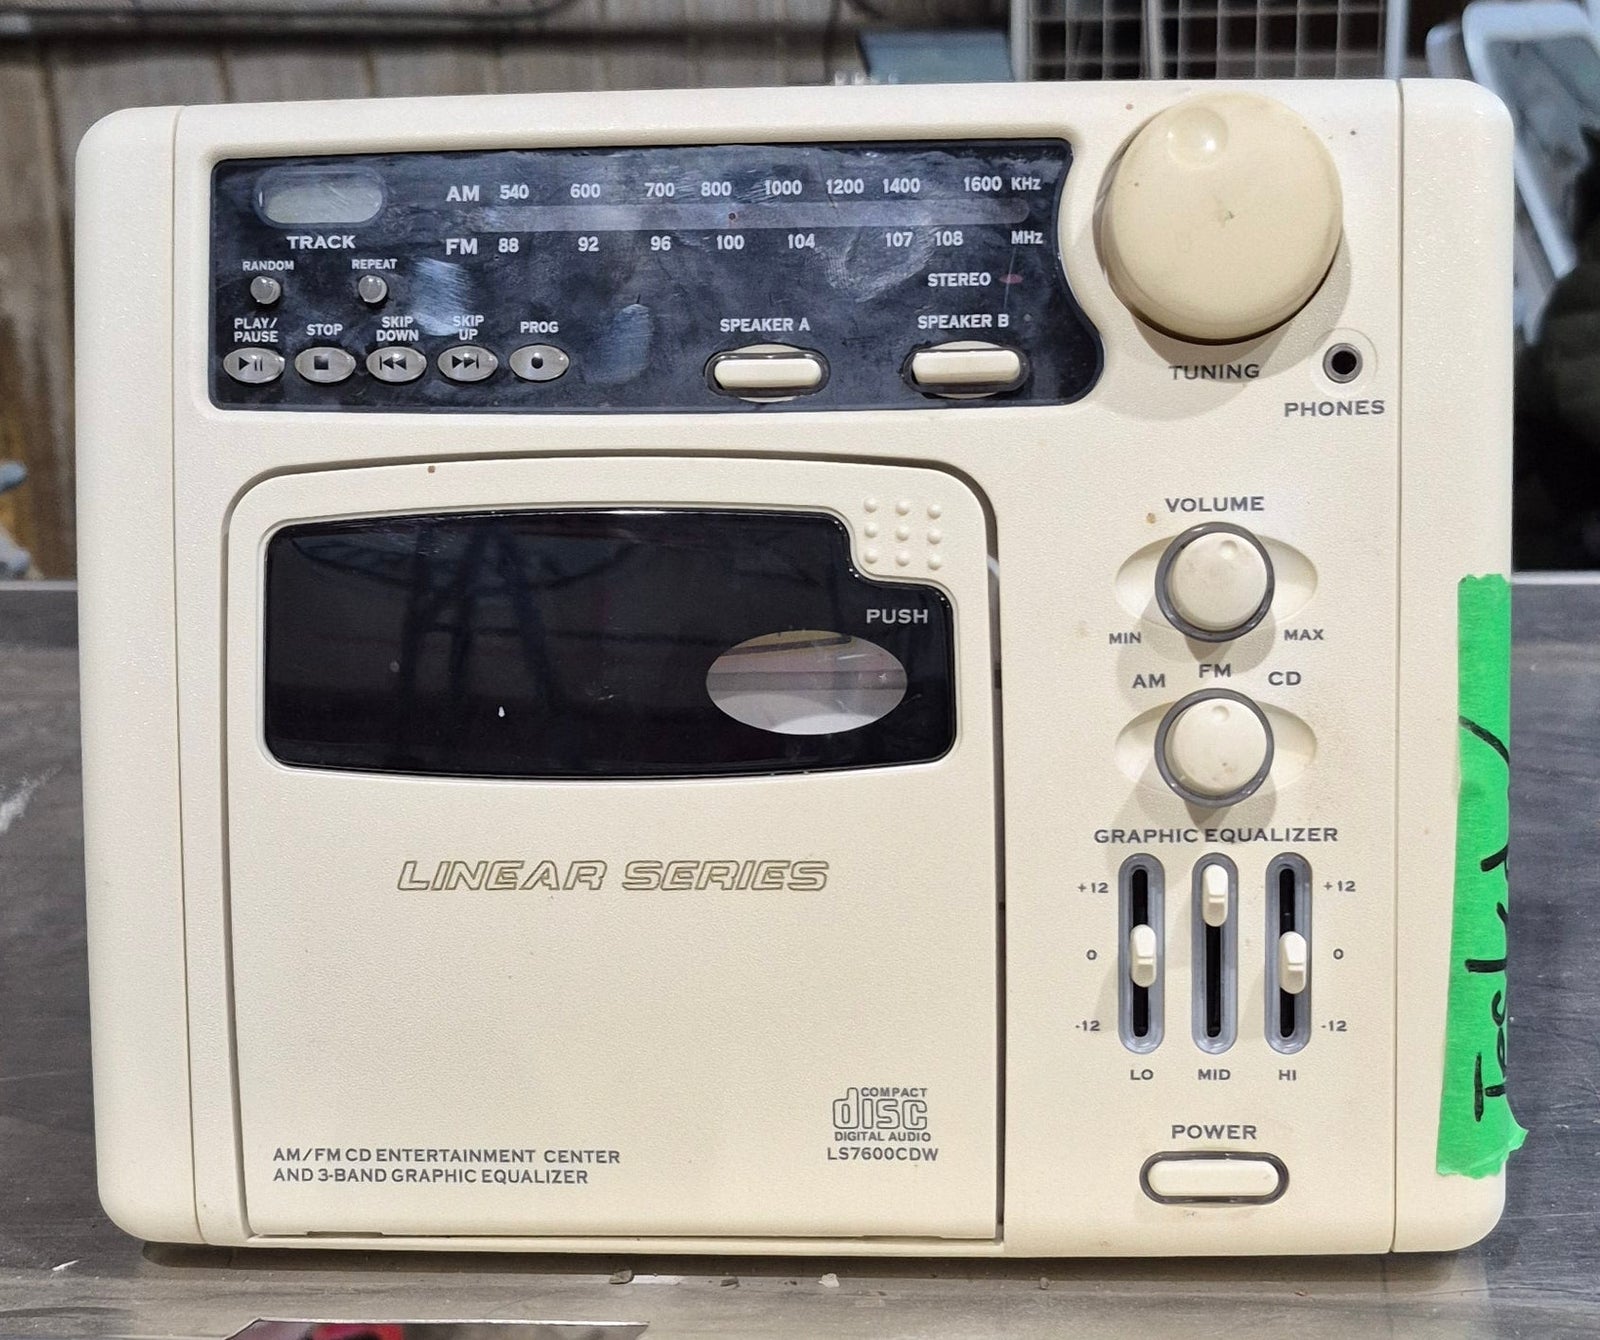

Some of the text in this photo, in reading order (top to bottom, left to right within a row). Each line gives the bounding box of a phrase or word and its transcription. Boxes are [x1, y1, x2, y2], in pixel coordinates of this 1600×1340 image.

[446, 175, 1041, 202] AM 540 600 700 800 1000 1200 1400 1600 KHz
[286, 235, 356, 250] TRACK
[446, 230, 1043, 255] FM 88 92 96 100 104 107 108 MHz
[242, 260, 295, 271] RANDOM
[351, 258, 397, 270] REPEAT
[927, 272, 991, 288] STEREO
[234, 317, 278, 331] PLAY/
[381, 316, 414, 329] SKIP
[453, 315, 484, 328] SKIP
[520, 321, 559, 334] PROG
[720, 318, 810, 332] SPEAKER A
[917, 314, 1010, 329] SPEAKER B
[233, 330, 278, 343] PAUSE
[306, 323, 343, 336] STOP
[376, 328, 419, 342] DOWN
[459, 327, 478, 341] UP
[1168, 364, 1260, 380] TUNING
[1284, 400, 1386, 417] PHONES
[1165, 496, 1264, 513] VOLUME
[866, 609, 928, 624] PUSH
[1109, 632, 1142, 644] MIN
[1284, 629, 1324, 641] MAX
[1198, 664, 1231, 678] FM
[1132, 674, 1166, 689] AM
[1268, 671, 1301, 686] CD
[1094, 828, 1338, 844] GRAPHIC EQUALIZER
[397, 860, 830, 891] LINEAR SERIES
[1077, 882, 1109, 894] +12
[1323, 880, 1356, 892] +12
[1086, 949, 1097, 961] 0
[1333, 948, 1344, 960] 0
[1075, 1020, 1101, 1032] -12
[1320, 1020, 1347, 1032] -12
[1130, 1069, 1154, 1081] LO
[1197, 1069, 1231, 1081] MID
[1278, 1069, 1297, 1081] HI
[860, 1087, 928, 1098] COMPACT
[832, 1087, 928, 1131] disc
[834, 1131, 931, 1142] DIGITAL AUDIO
[1171, 1124, 1257, 1140] POWER
[272, 1147, 621, 1165] AM/FM CD ENTERTAINMENT CENTER
[827, 1147, 939, 1161] LS7600CDW
[272, 1169, 589, 1185] AND 3-BAND GRAPHIC EQUALIZER
